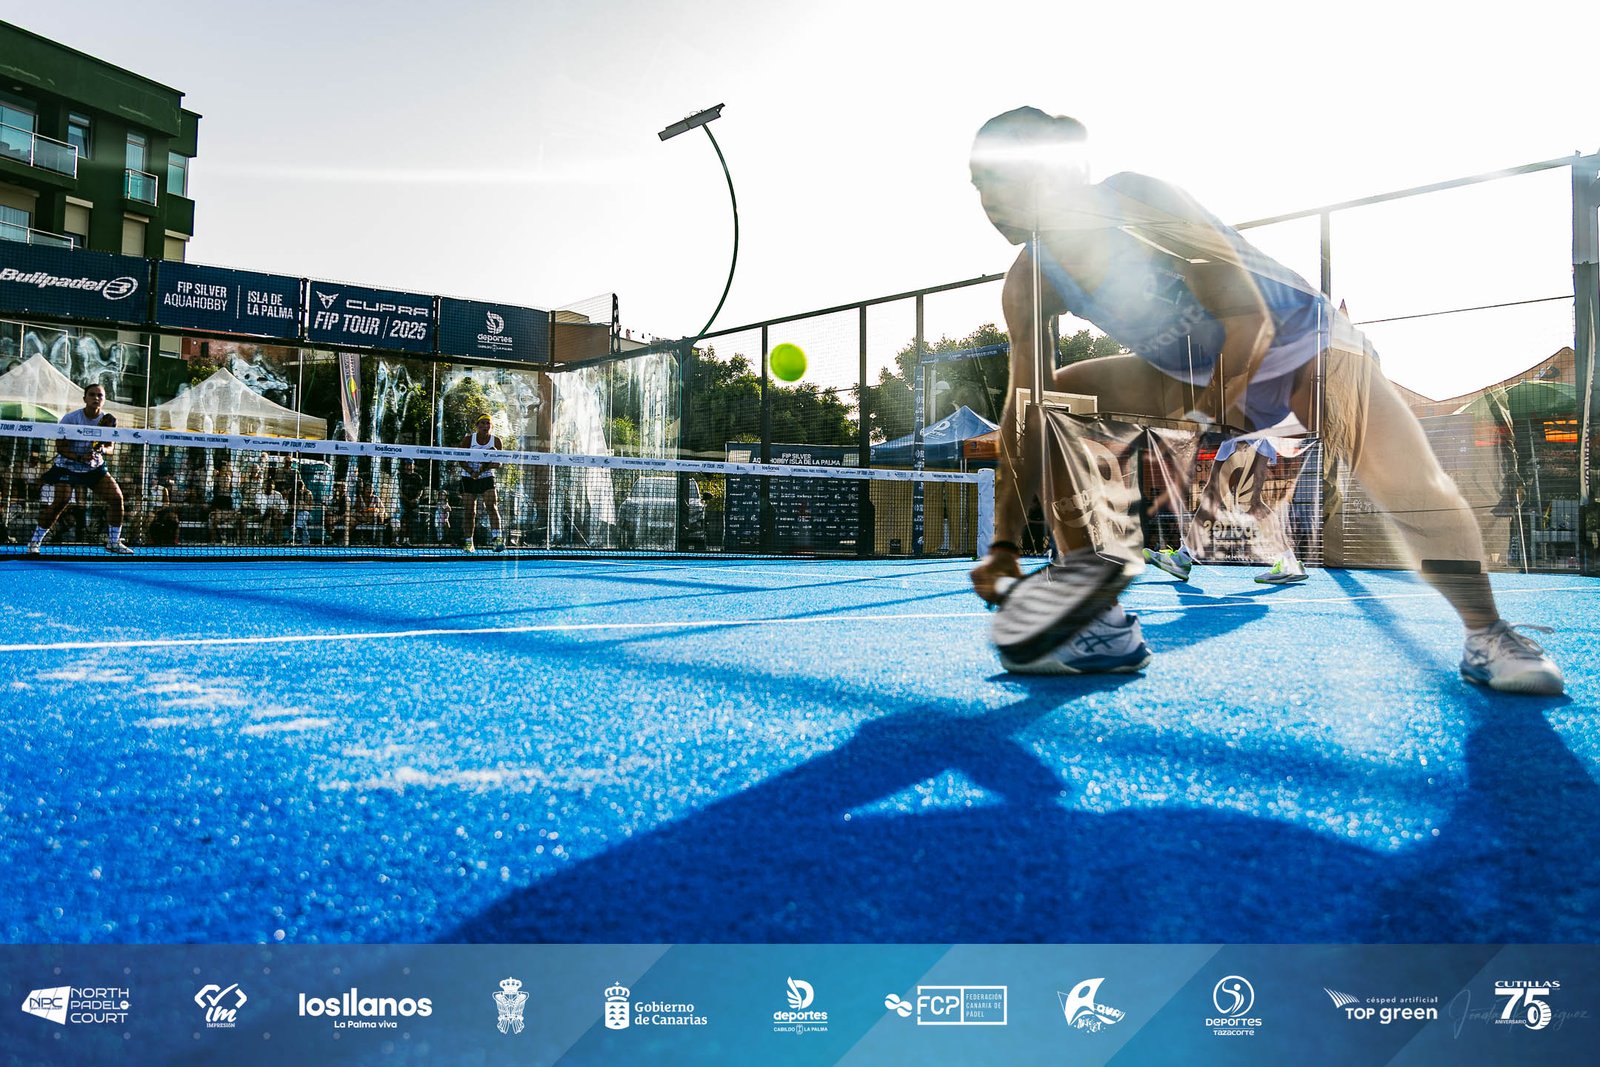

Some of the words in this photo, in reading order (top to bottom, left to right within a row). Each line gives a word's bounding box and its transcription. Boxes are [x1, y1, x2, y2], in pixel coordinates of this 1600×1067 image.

[0, 267, 107, 291] Bullpadel
[177, 281, 193, 294] FIP
[194, 283, 227, 298] SILVER
[247, 290, 268, 304] ISLA
[270, 294, 283, 306] DE
[164, 293, 228, 311] AQUAHOBBY
[345, 299, 429, 318] CUPRA
[247, 303, 259, 316] LA
[261, 305, 293, 320] PALMA
[313, 311, 339, 331] FIP
[342, 313, 380, 336] TOUR
[389, 320, 428, 341] 2025
[477, 333, 513, 343] deportes
[0, 422, 16, 432] TOUR
[18, 424, 33, 432] 2025
